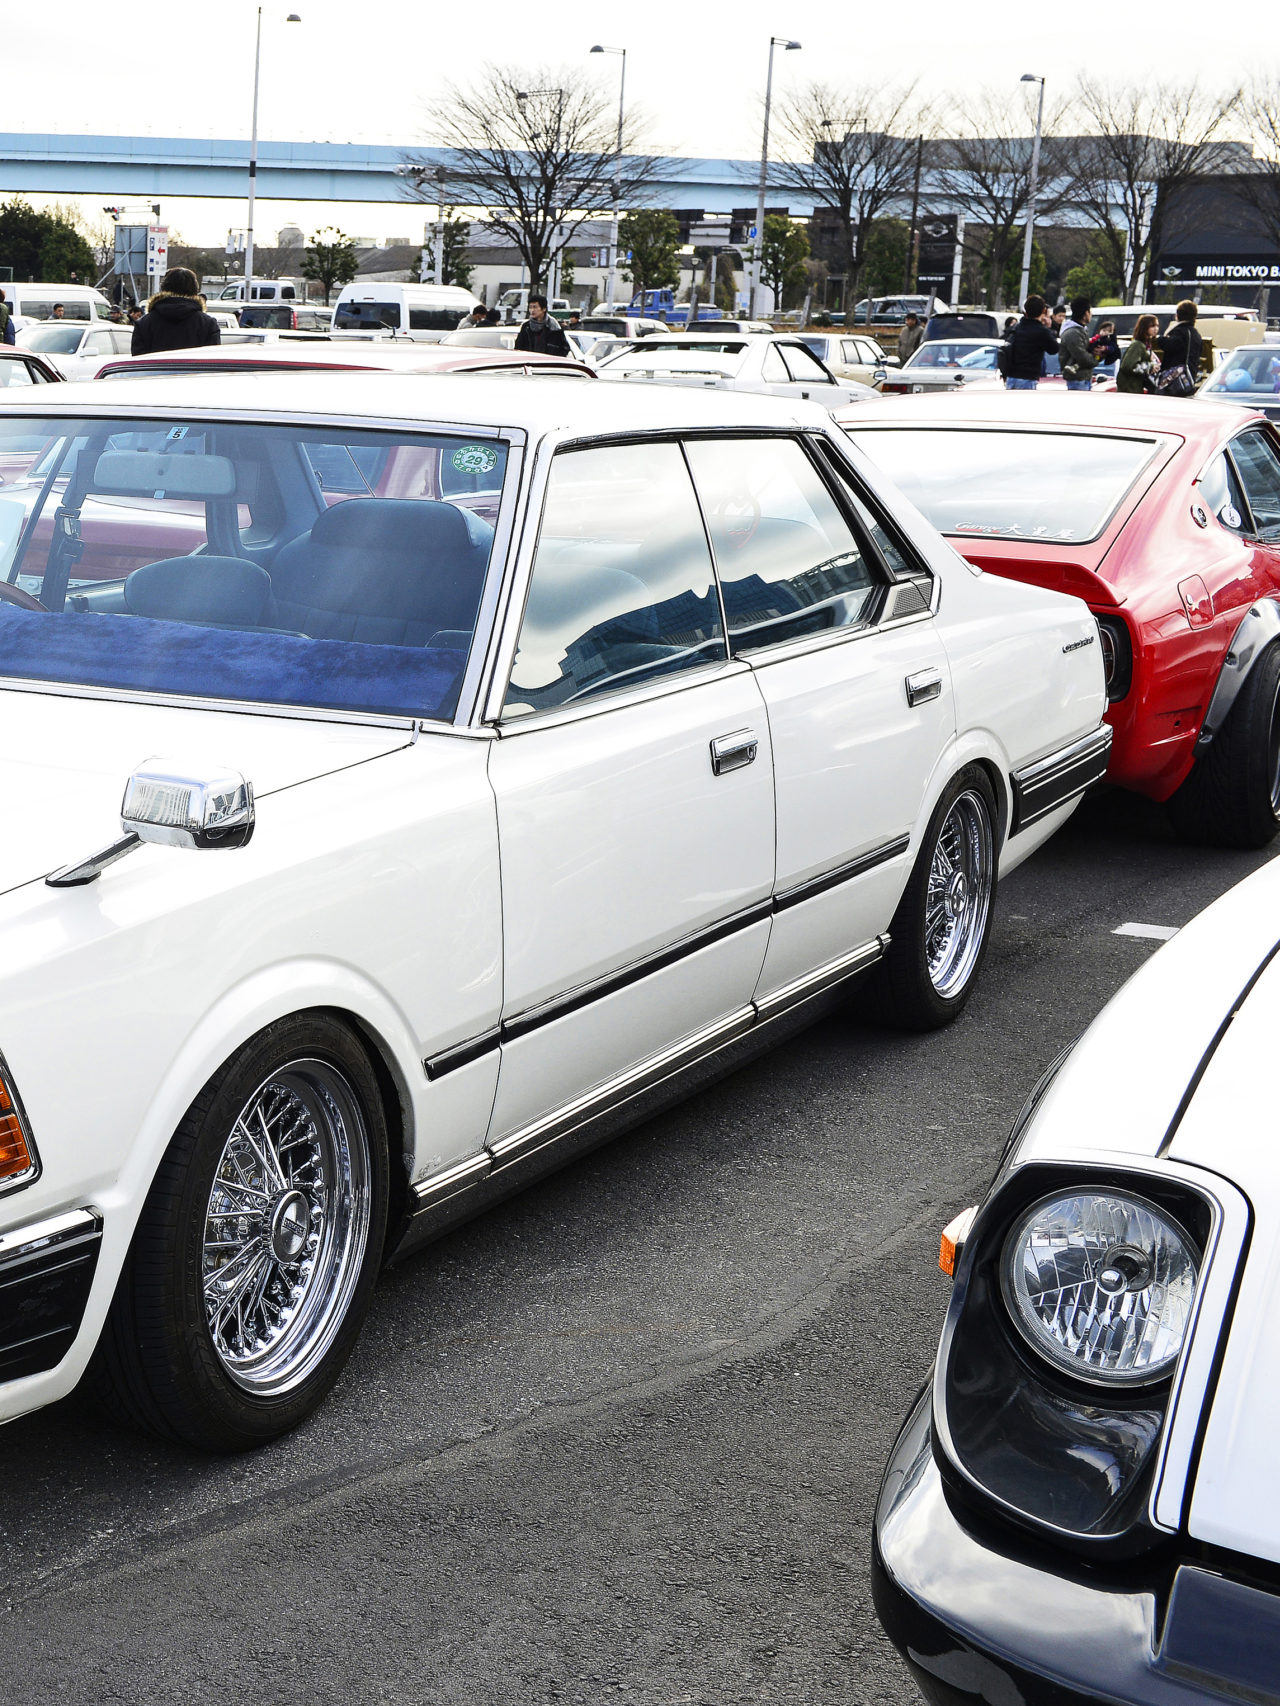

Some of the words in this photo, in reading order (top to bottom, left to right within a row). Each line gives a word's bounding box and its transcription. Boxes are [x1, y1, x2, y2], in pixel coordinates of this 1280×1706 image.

[1196, 265, 1225, 277] MINI
[1225, 265, 1269, 277] TOKYO
[1270, 265, 1280, 277] B
[172, 431, 182, 439] 5
[465, 454, 483, 466] 29
